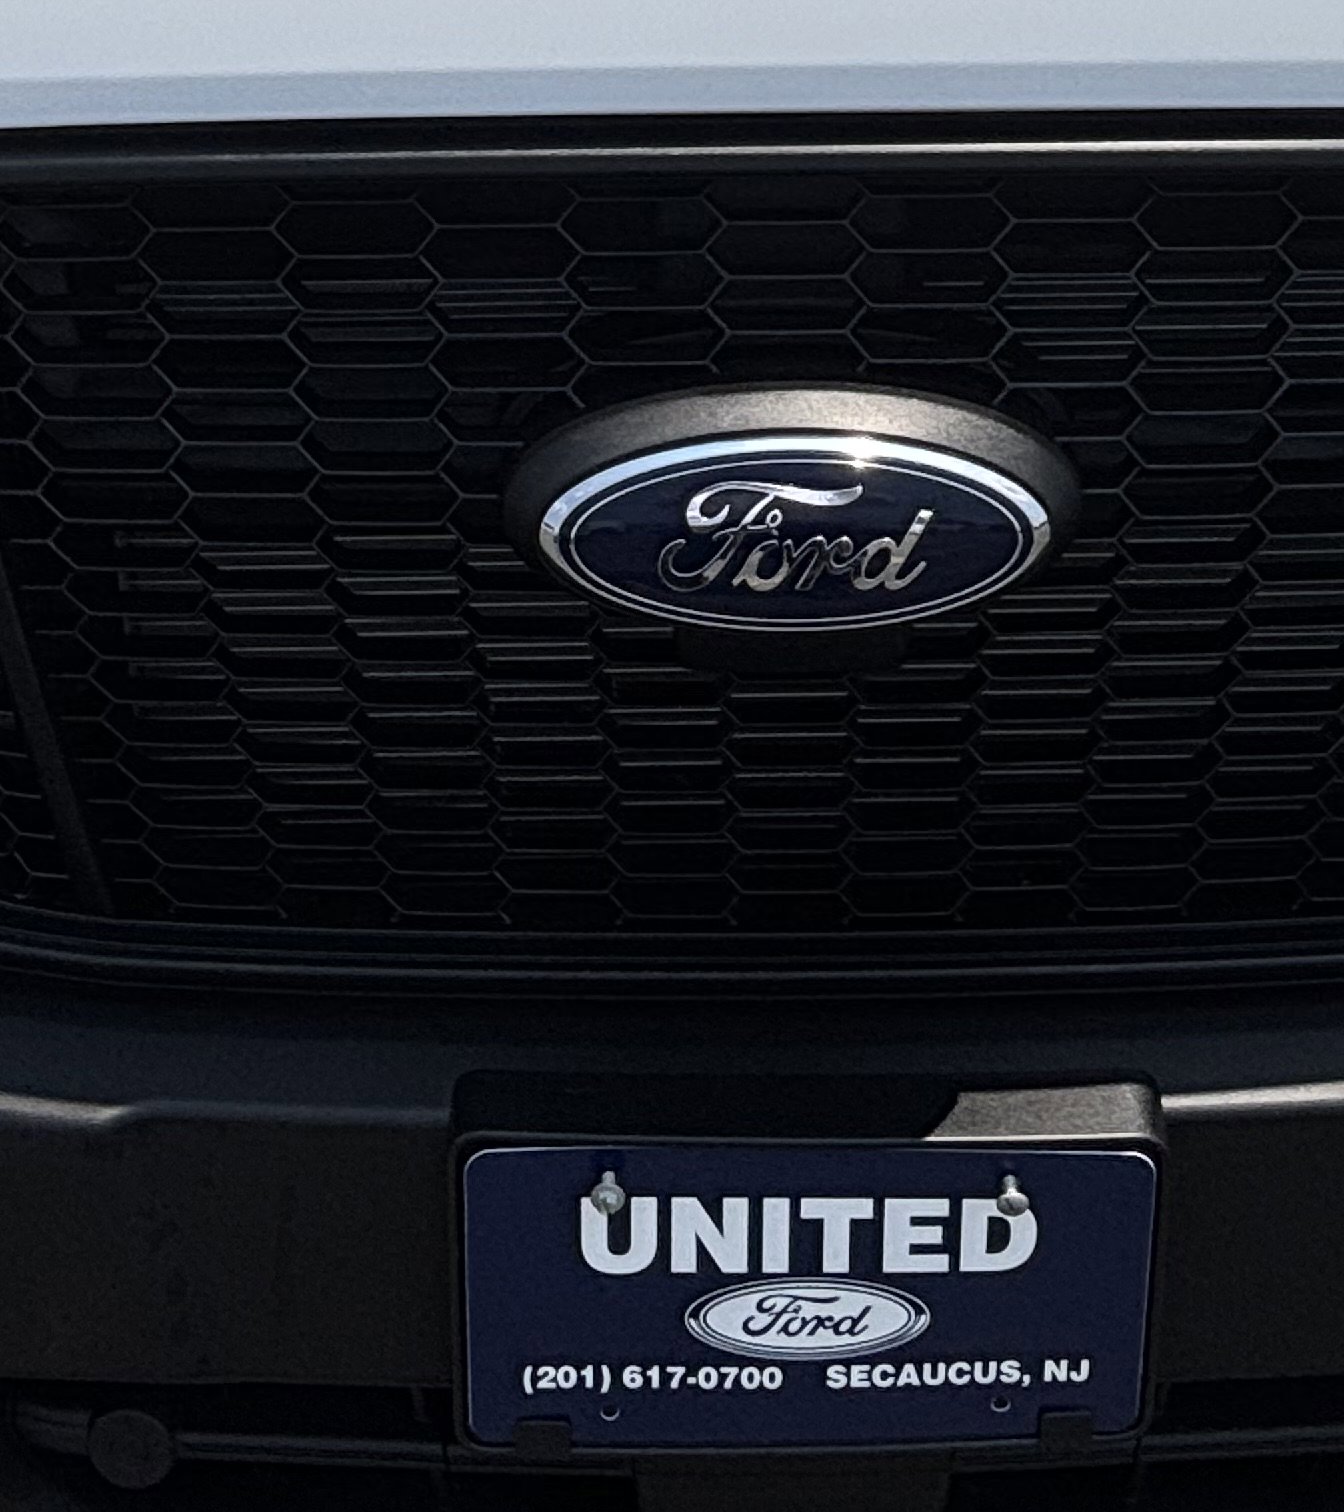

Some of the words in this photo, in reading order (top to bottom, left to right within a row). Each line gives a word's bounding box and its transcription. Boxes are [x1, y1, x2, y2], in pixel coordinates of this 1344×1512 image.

[658, 481, 935, 591] Ford
[579, 1196, 1039, 1274] UNITED
[742, 1291, 871, 1339] Ford
[522, 1365, 611, 1395] (201)
[622, 1366, 784, 1390] 617-0700
[825, 1360, 1031, 1389] SECAUCUS,
[1043, 1359, 1091, 1383] NJ
